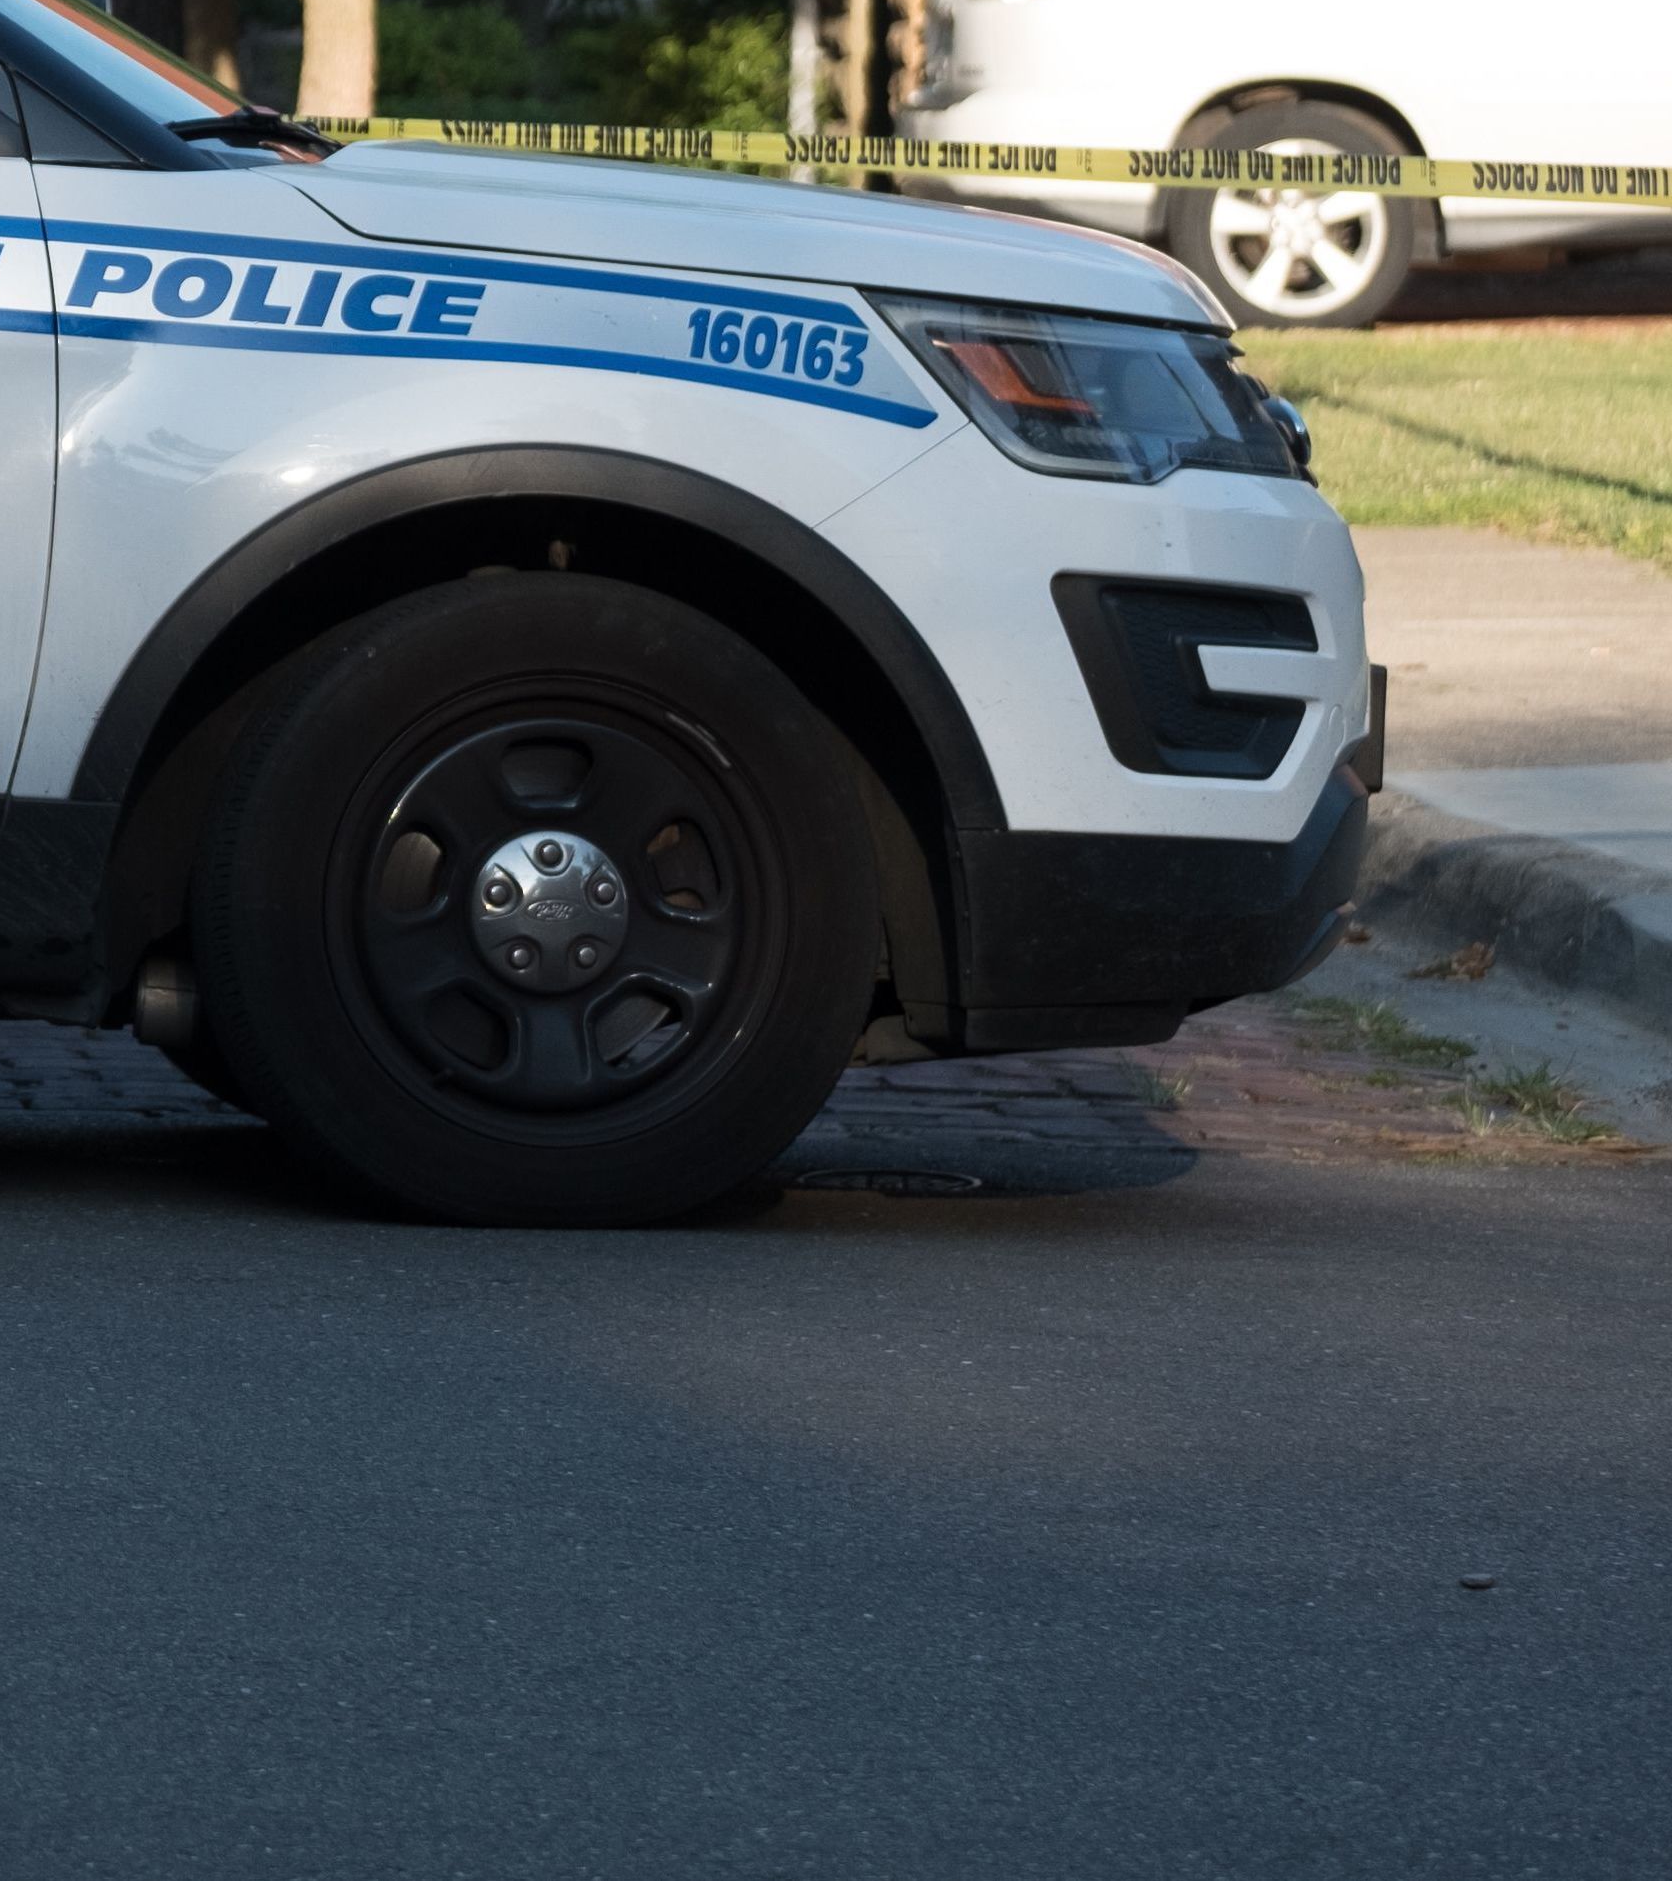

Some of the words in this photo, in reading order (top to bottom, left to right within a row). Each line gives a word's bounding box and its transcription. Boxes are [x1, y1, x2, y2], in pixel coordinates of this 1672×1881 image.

[785, 134, 850, 164] CROSS
[857, 136, 896, 165] NOT
[905, 137, 929, 167] DO
[937, 140, 980, 169] LINE
[988, 143, 1056, 172] POLICE
[1129, 148, 1194, 179] CROSS
[1201, 149, 1240, 179] NOT
[1248, 150, 1274, 181] DO
[1282, 155, 1324, 183] LINE
[1332, 154, 1401, 186] POLICE
[1472, 161, 1538, 192] CROSS
[1545, 164, 1584, 194] NOT
[1592, 166, 1618, 195] DO
[65, 249, 487, 336] POLICE
[688, 307, 869, 387] 160163
